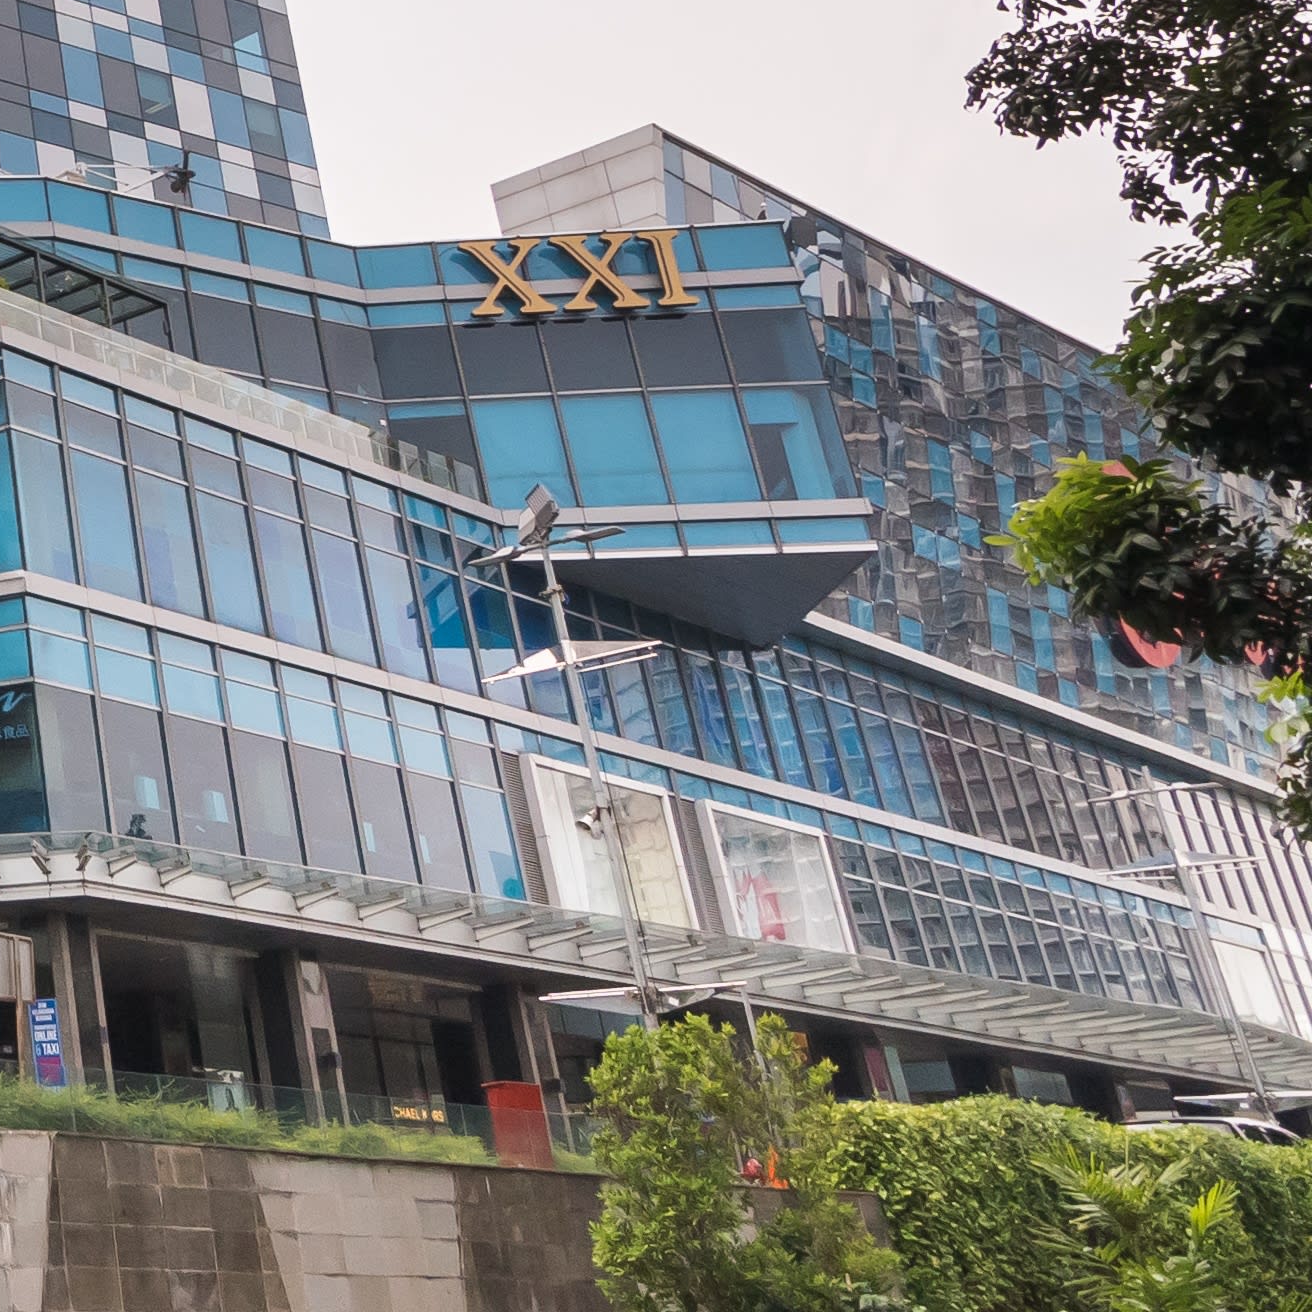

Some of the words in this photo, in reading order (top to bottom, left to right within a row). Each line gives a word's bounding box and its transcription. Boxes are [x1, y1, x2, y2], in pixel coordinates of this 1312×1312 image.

[457, 229, 700, 318] XXI
[34, 1030, 58, 1042] ONLINE
[42, 1042, 60, 1055] TAXI
